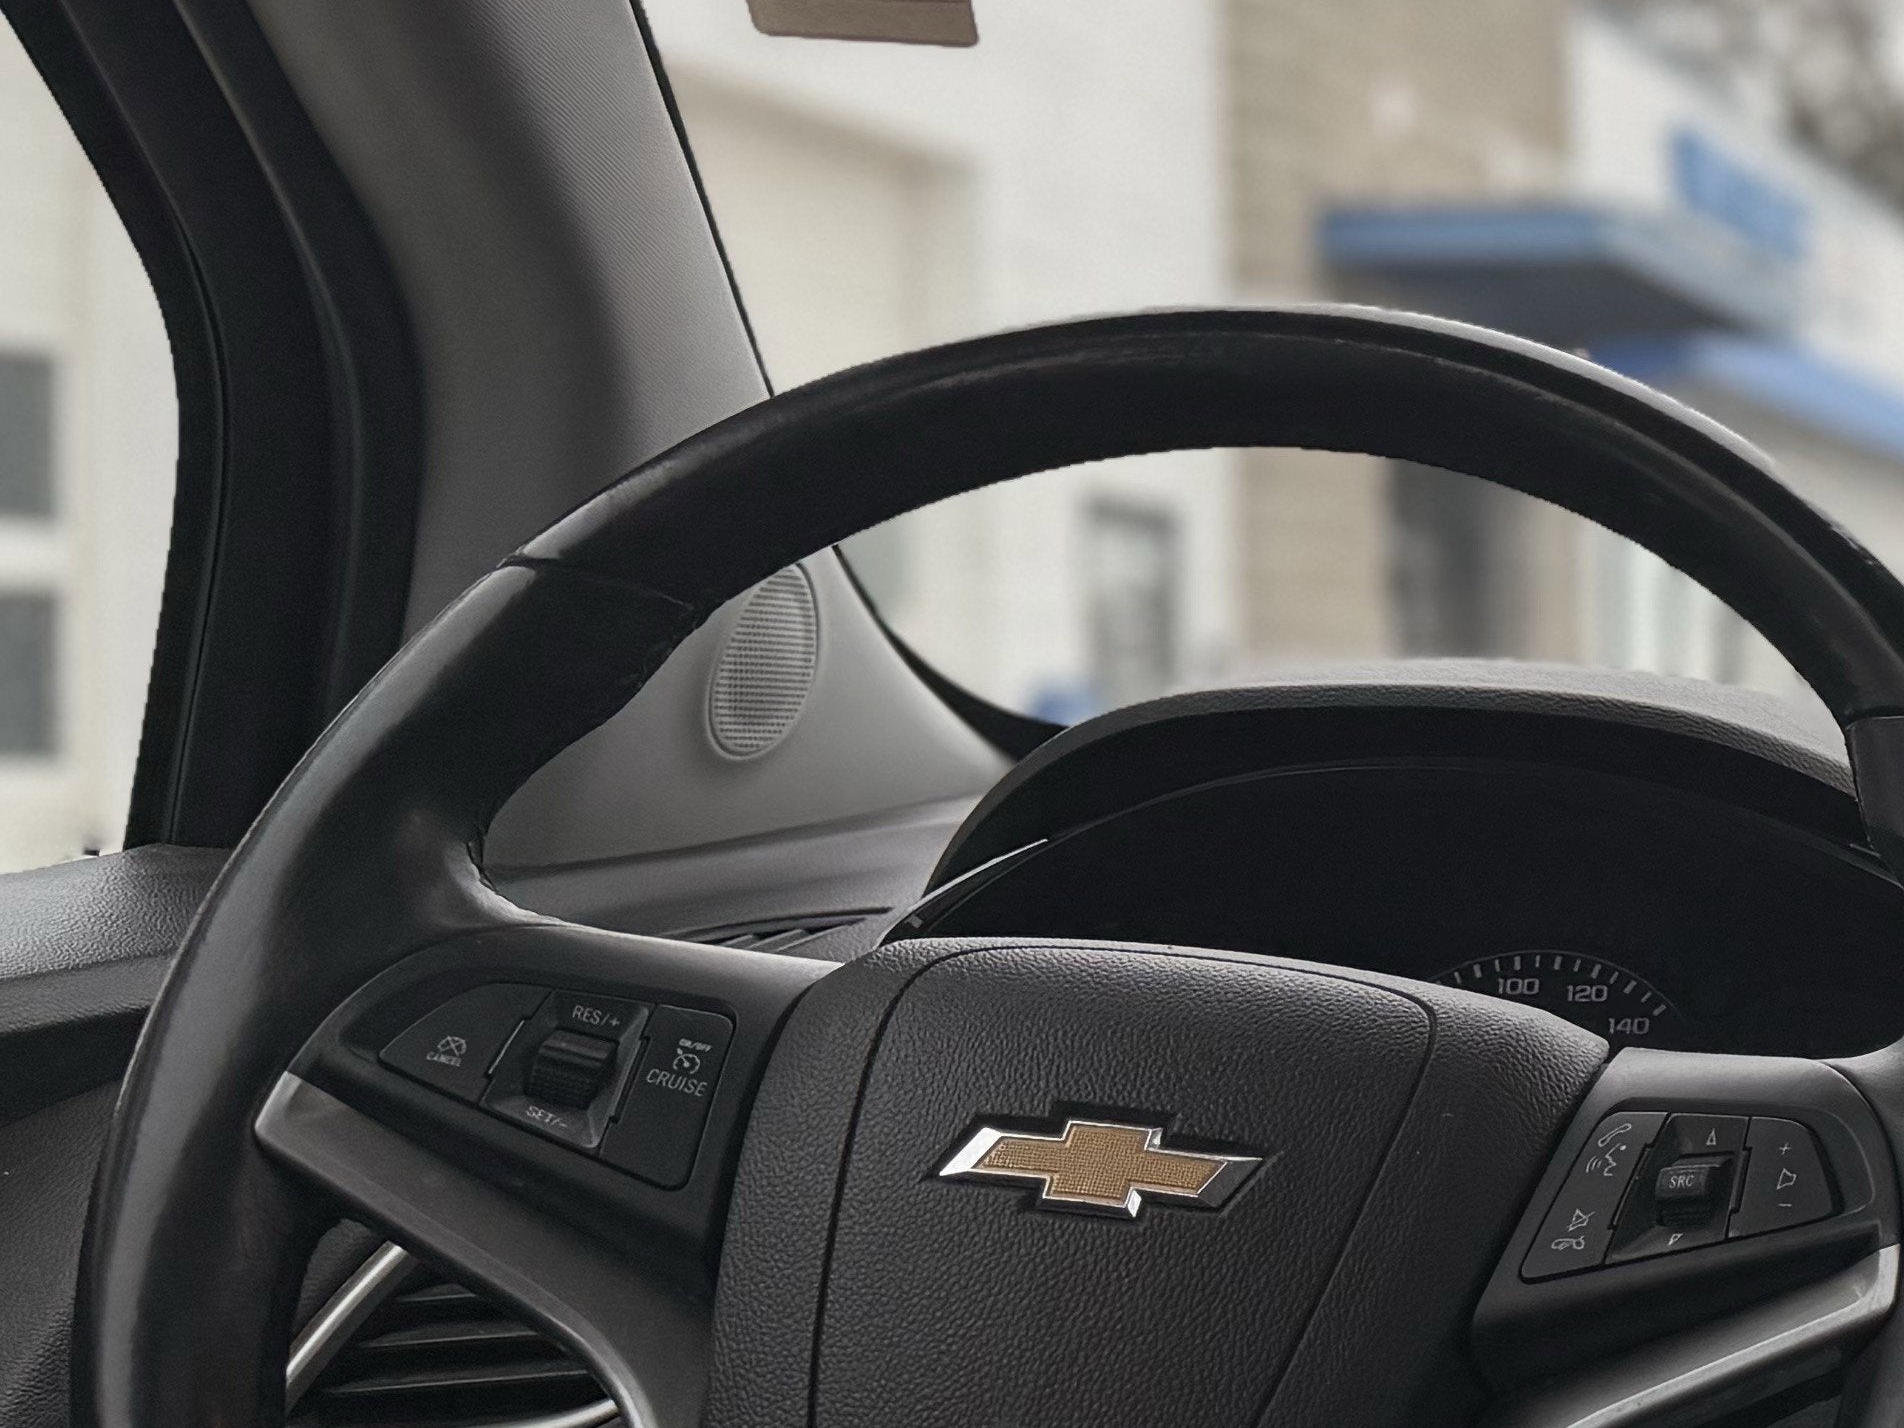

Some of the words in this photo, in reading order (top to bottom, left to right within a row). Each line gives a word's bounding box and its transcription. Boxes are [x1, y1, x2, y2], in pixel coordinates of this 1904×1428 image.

[1498, 977, 1540, 996] 100
[1567, 984, 1609, 1003] 120
[1608, 1017, 1650, 1036] 140
[646, 1068, 708, 1098] CRUISE
[1668, 1173, 1696, 1190] SRC
